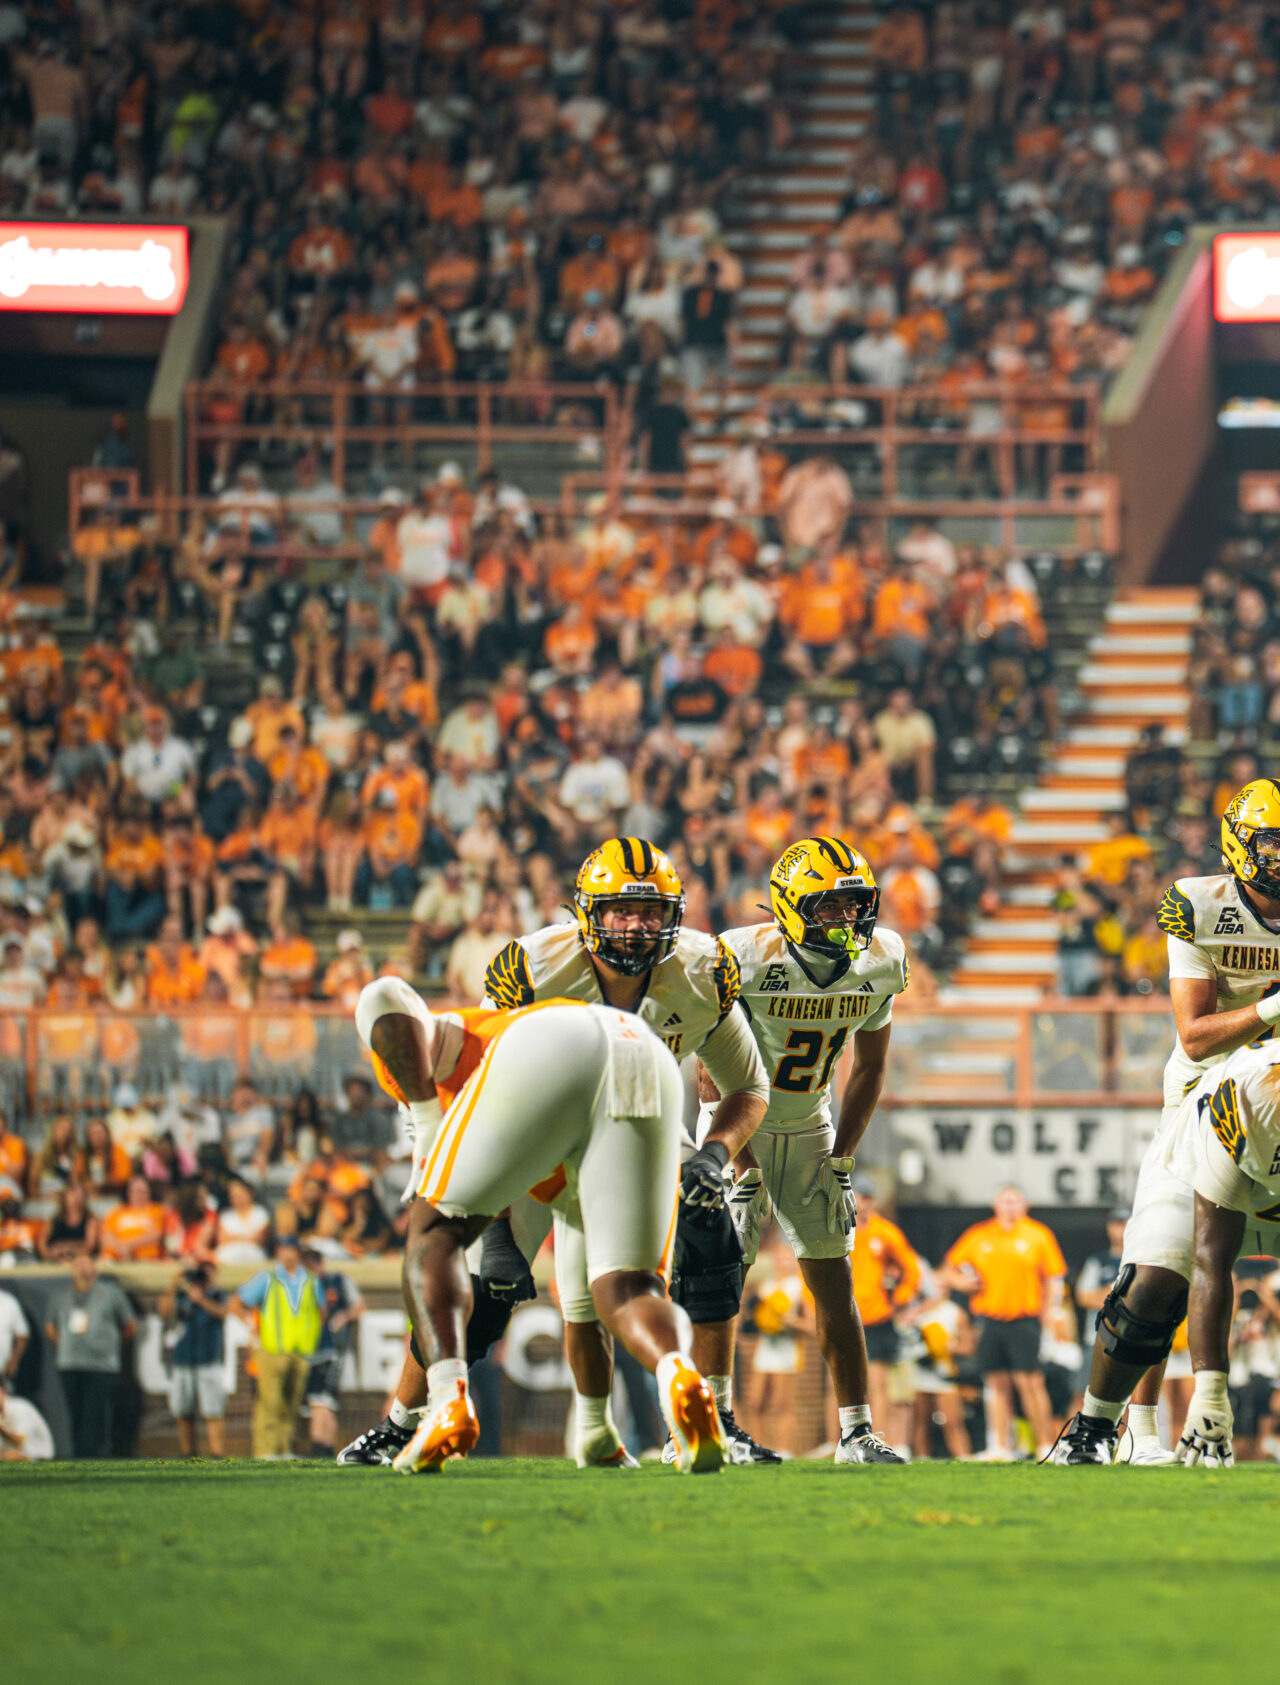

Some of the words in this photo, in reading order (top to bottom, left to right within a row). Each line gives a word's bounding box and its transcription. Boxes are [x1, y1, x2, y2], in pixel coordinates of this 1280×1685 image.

[840, 878, 864, 887] STRAIN
[626, 885, 655, 893] STRAIN
[1213, 923, 1244, 935] USA
[759, 980, 790, 992] USA
[768, 996, 835, 1020] KENNESAW
[838, 995, 871, 1018] STATE
[772, 1025, 850, 1094] 21
